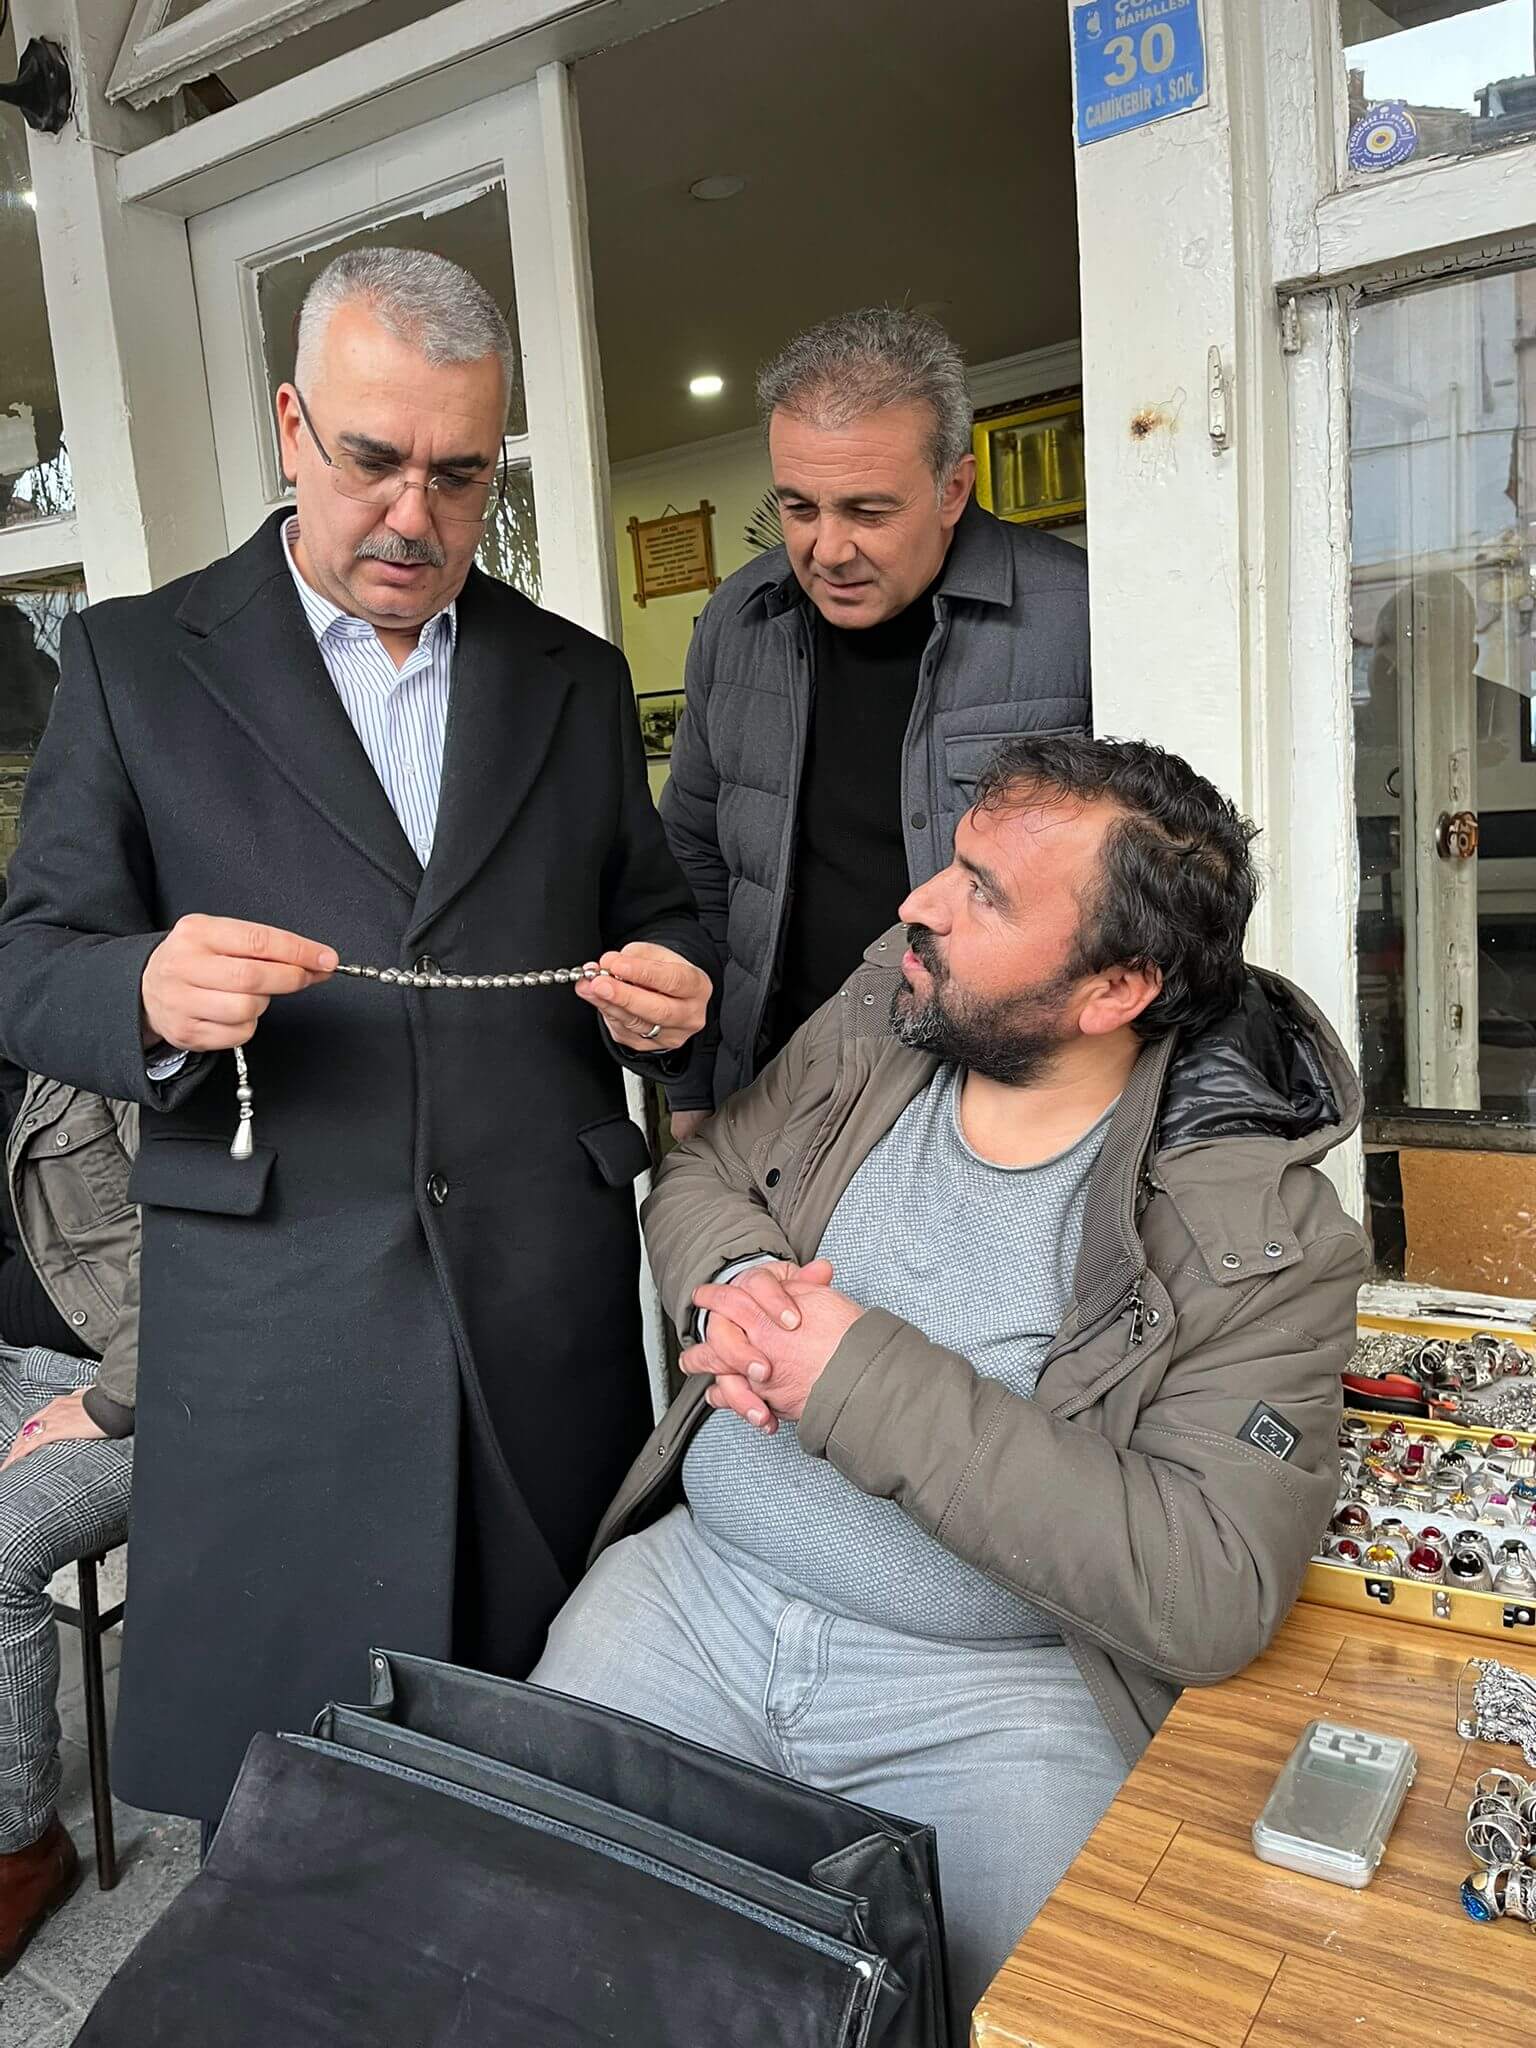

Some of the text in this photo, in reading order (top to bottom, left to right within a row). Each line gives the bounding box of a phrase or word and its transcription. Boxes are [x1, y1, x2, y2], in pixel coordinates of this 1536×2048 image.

[1103, 23, 1175, 86] 30
[1155, 83, 1166, 106] 3.
[1169, 72, 1198, 102] SOK.
